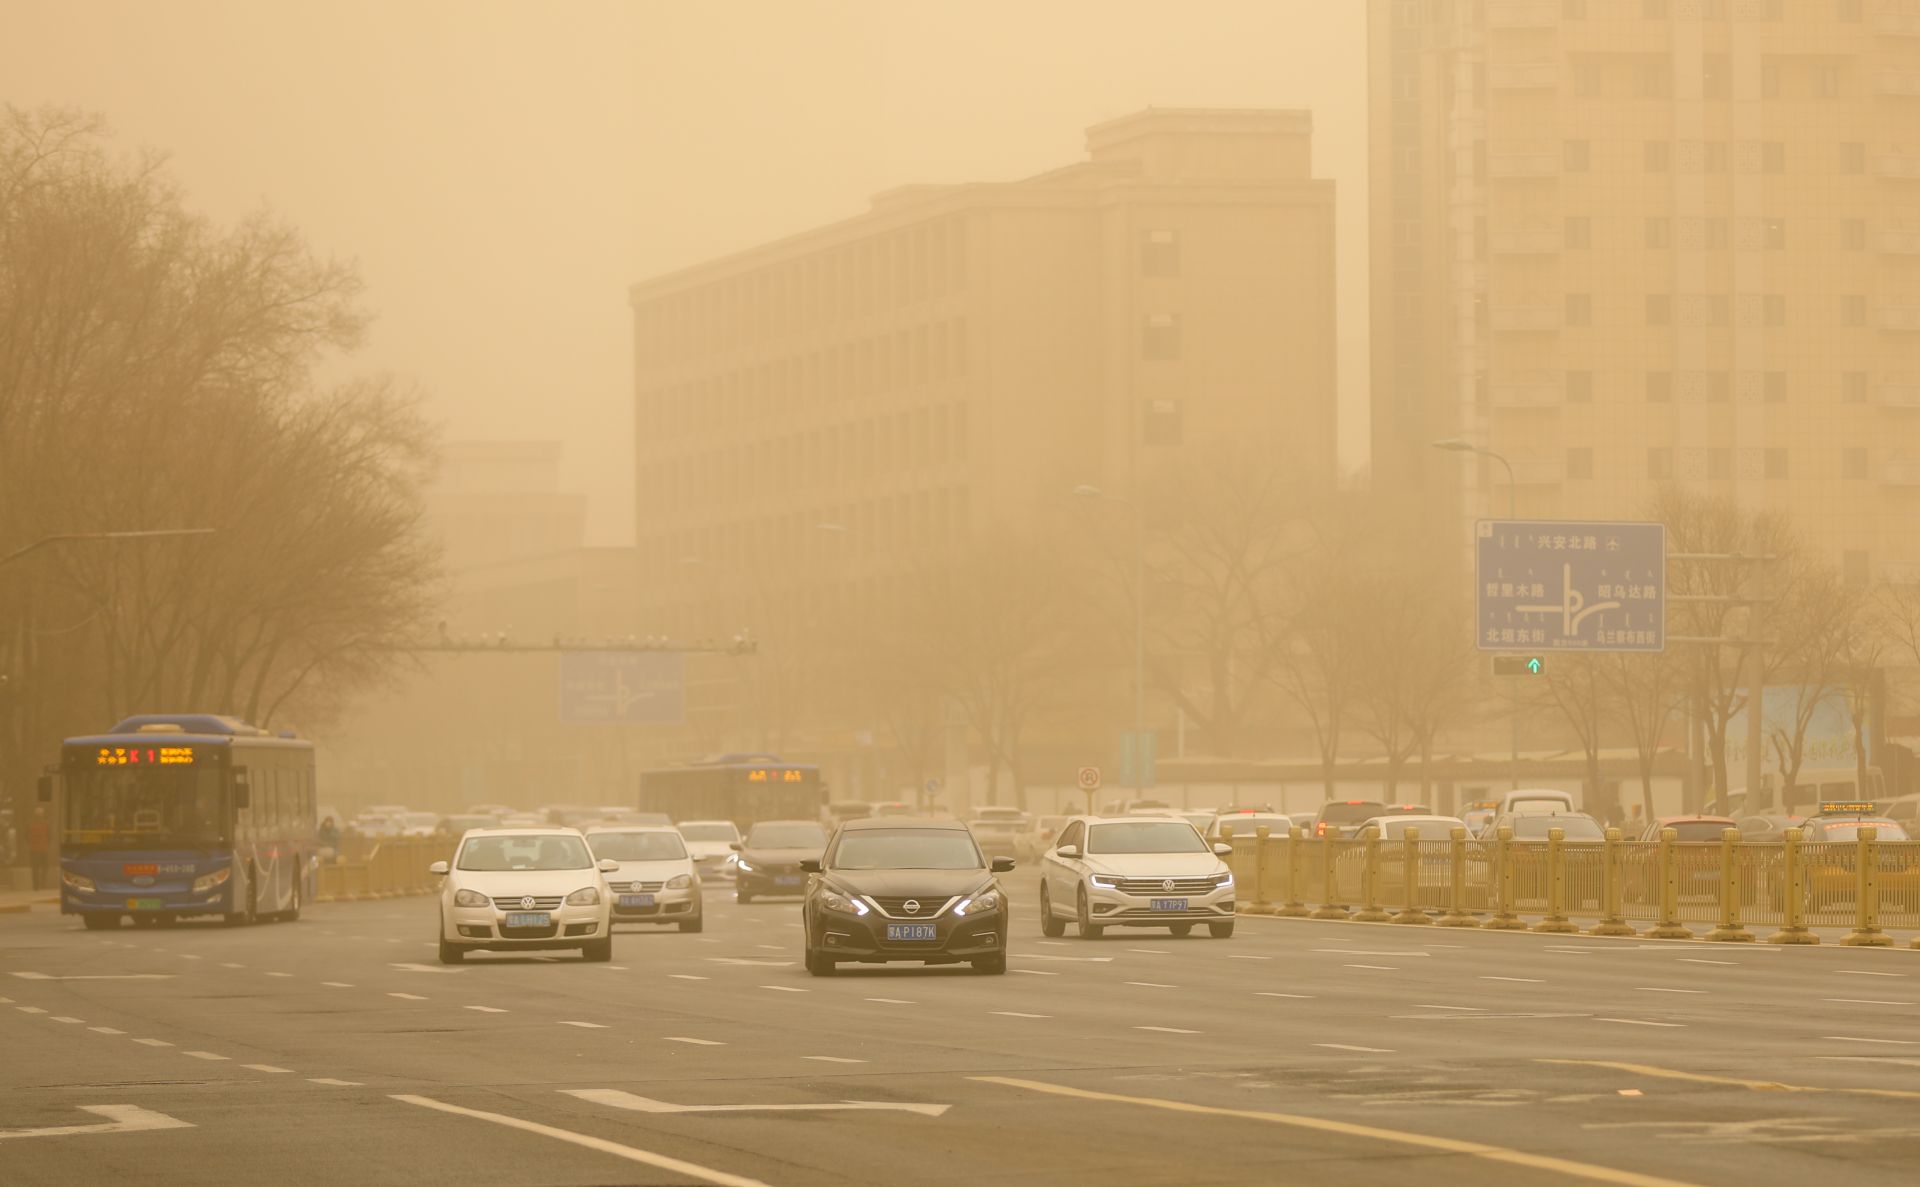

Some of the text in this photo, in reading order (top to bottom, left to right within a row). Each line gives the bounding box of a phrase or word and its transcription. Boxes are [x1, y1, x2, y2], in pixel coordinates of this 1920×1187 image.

[1537, 535, 1597, 550] 兴安北路
[1486, 583, 1545, 598] 哲里木路
[1598, 584, 1657, 599] 昭乌达路
[1487, 628, 1545, 643] 北垣东街
